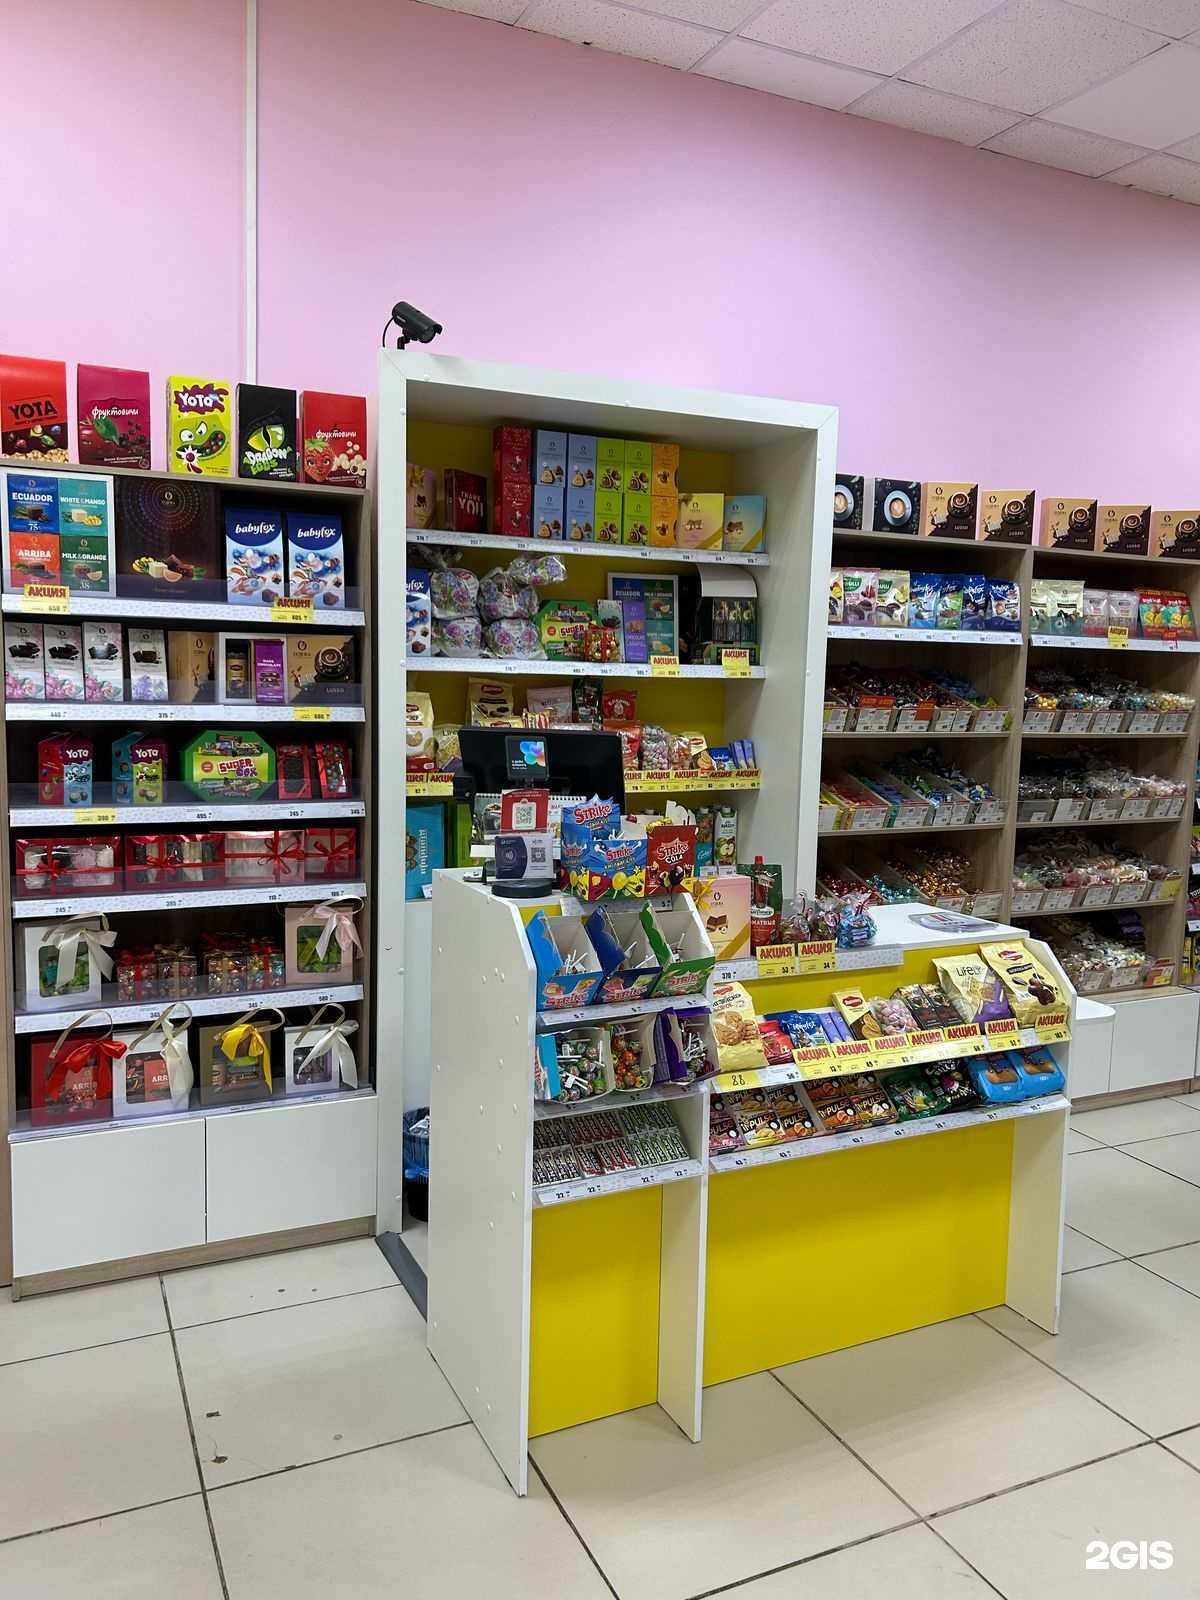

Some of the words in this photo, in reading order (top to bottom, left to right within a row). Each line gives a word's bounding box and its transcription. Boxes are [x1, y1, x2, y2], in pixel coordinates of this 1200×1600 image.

[8, 400, 58, 421] YOTA
[91, 405, 139, 419] фруктовичи
[12, 493, 53, 503] ECUADOR
[235, 522, 276, 534] babyfox
[297, 527, 337, 539] babyfox
[17, 549, 52, 558] ARRIBA
[83, 553, 107, 561] ORANGE
[219, 758, 254, 773] SUPER
[759, 946, 793, 959] АКЦИЯ
[801, 942, 833, 955] АКЦИЯ
[1038, 1014, 1064, 1026] АКЦИЯ
[947, 1025, 978, 1039] АКЦИЯ
[987, 1020, 1016, 1034] АКЦИЯ
[874, 1036, 907, 1051] АКЦИЯ
[911, 1031, 943, 1045] АКЦИЯ
[798, 1047, 831, 1062] АКЦИЯ
[836, 1041, 870, 1056] АКЦИЯ
[152, 1074, 169, 1082] ARR
